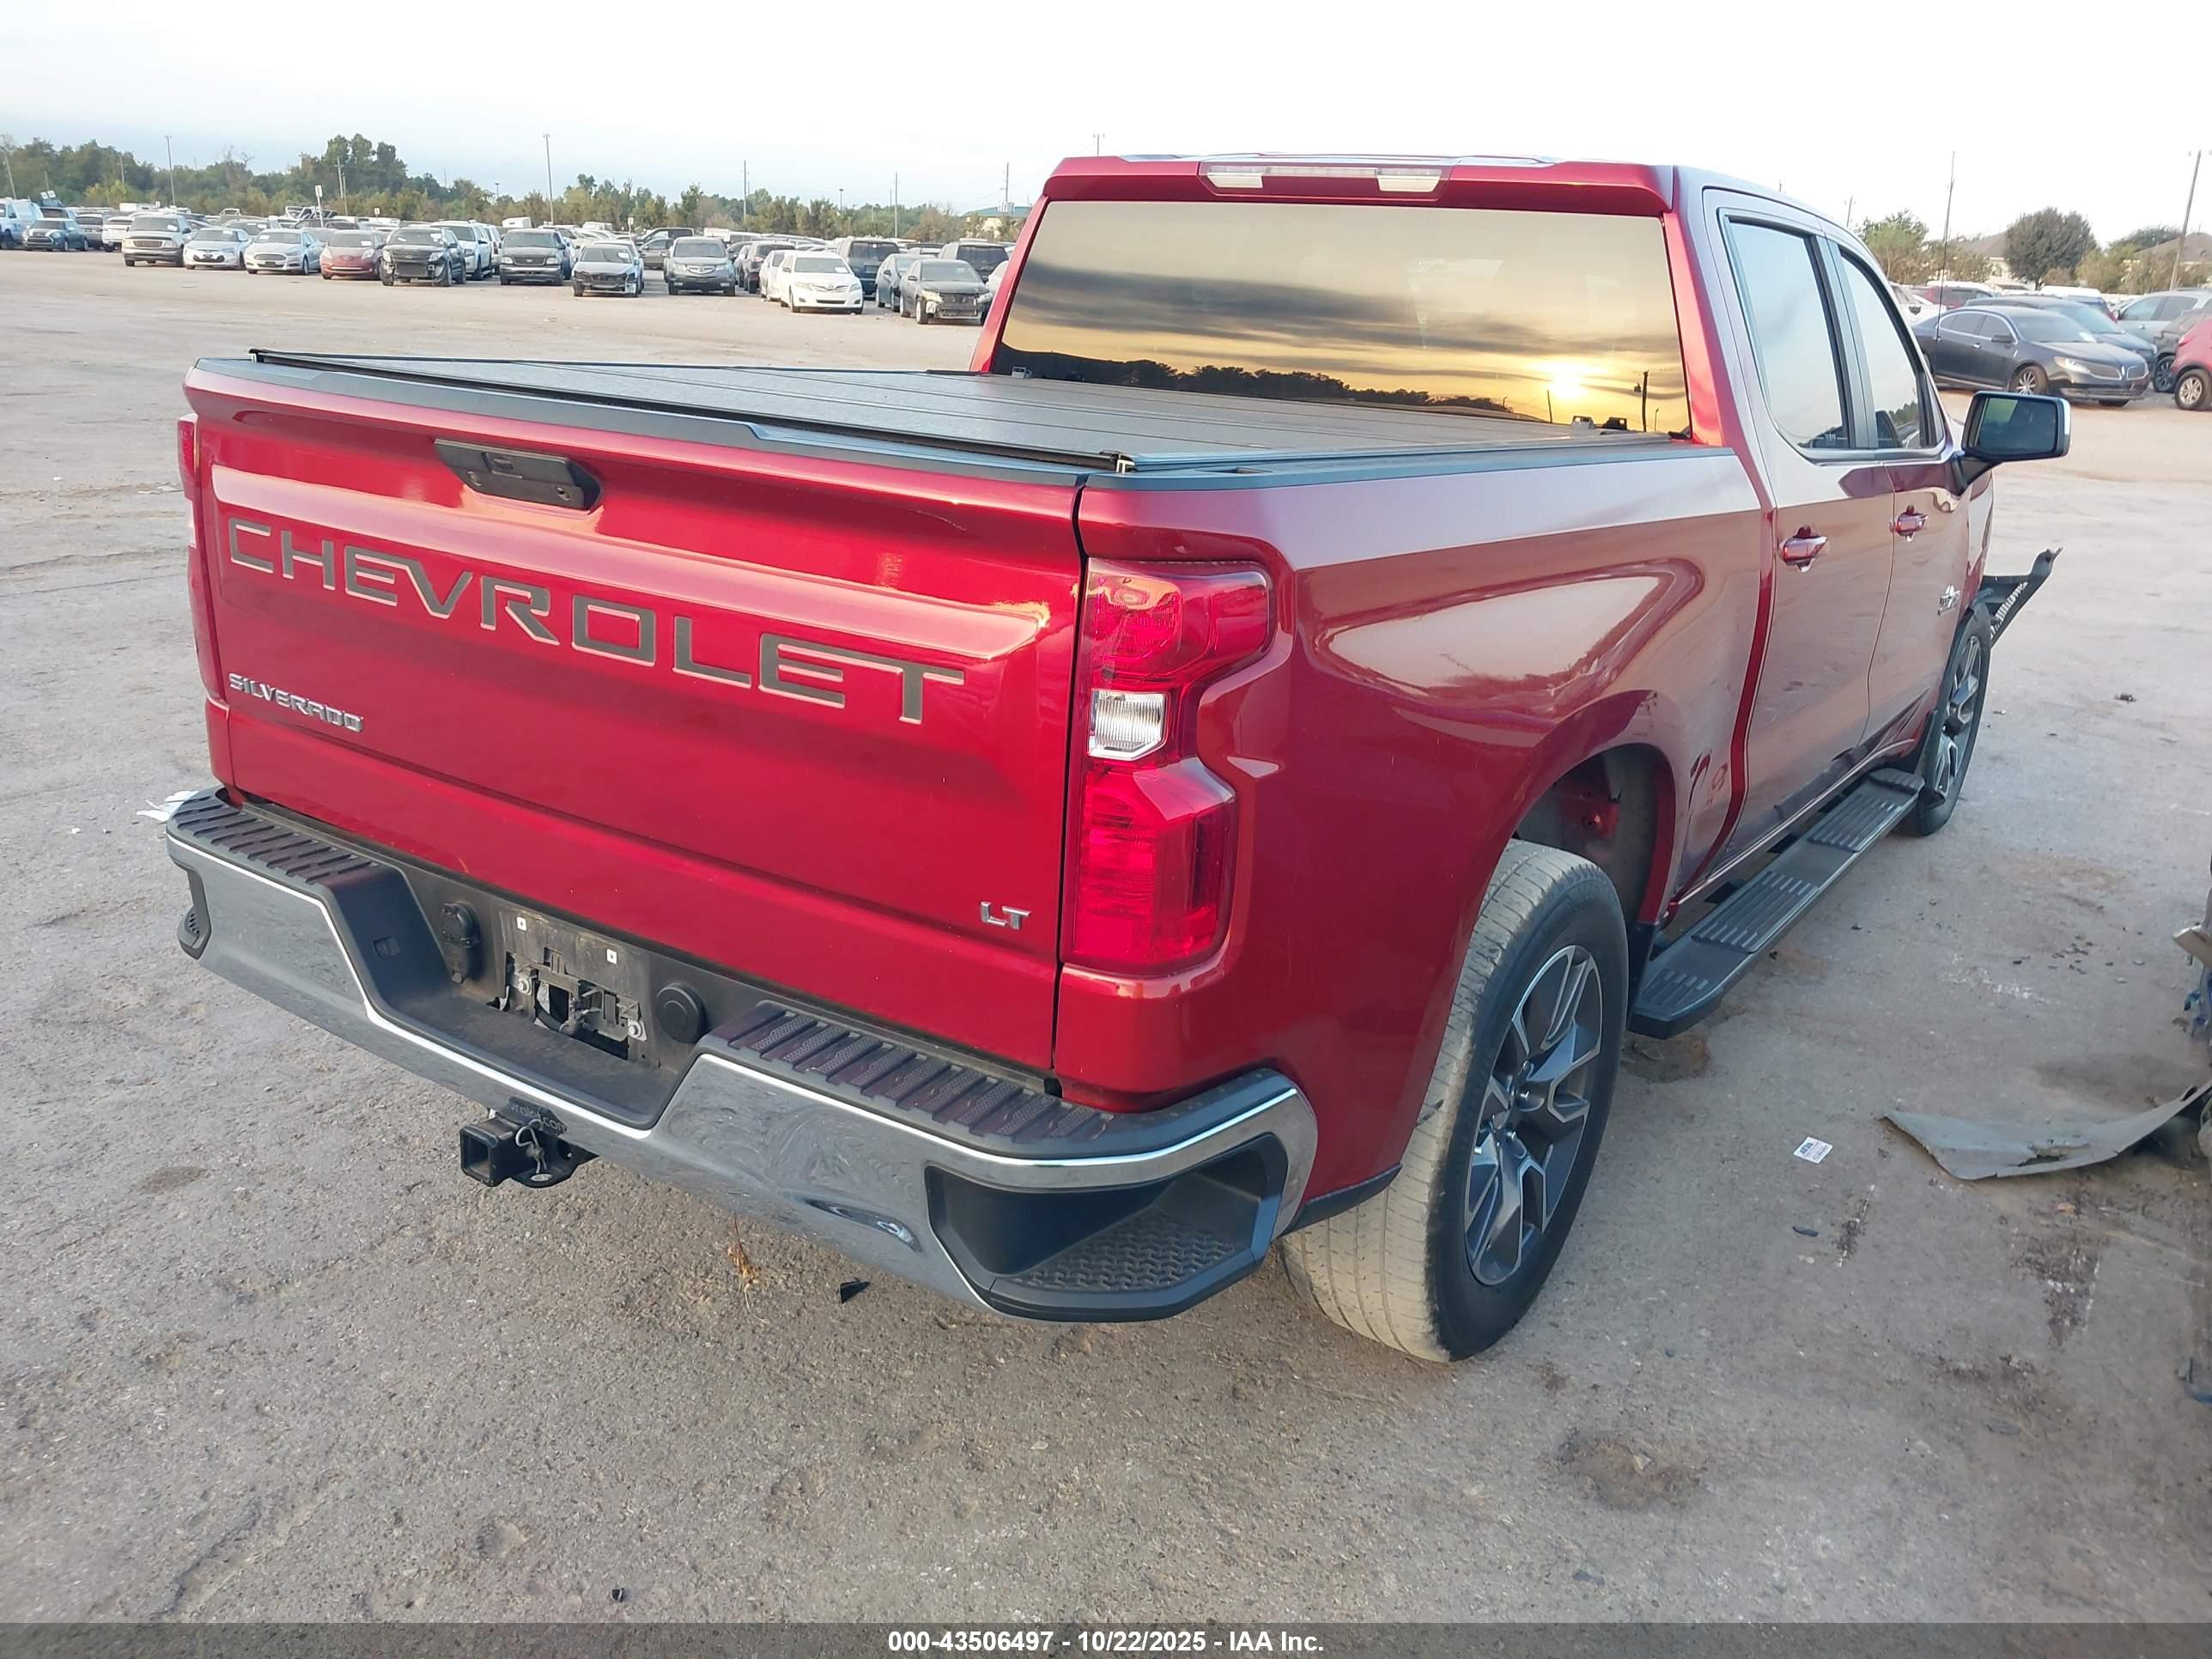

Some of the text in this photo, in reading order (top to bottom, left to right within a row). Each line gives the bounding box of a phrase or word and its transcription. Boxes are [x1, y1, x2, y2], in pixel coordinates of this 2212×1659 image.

[228, 517, 965, 725] CHEVROLET
[228, 672, 364, 732] SILVERADO
[980, 901, 1032, 930] LT
